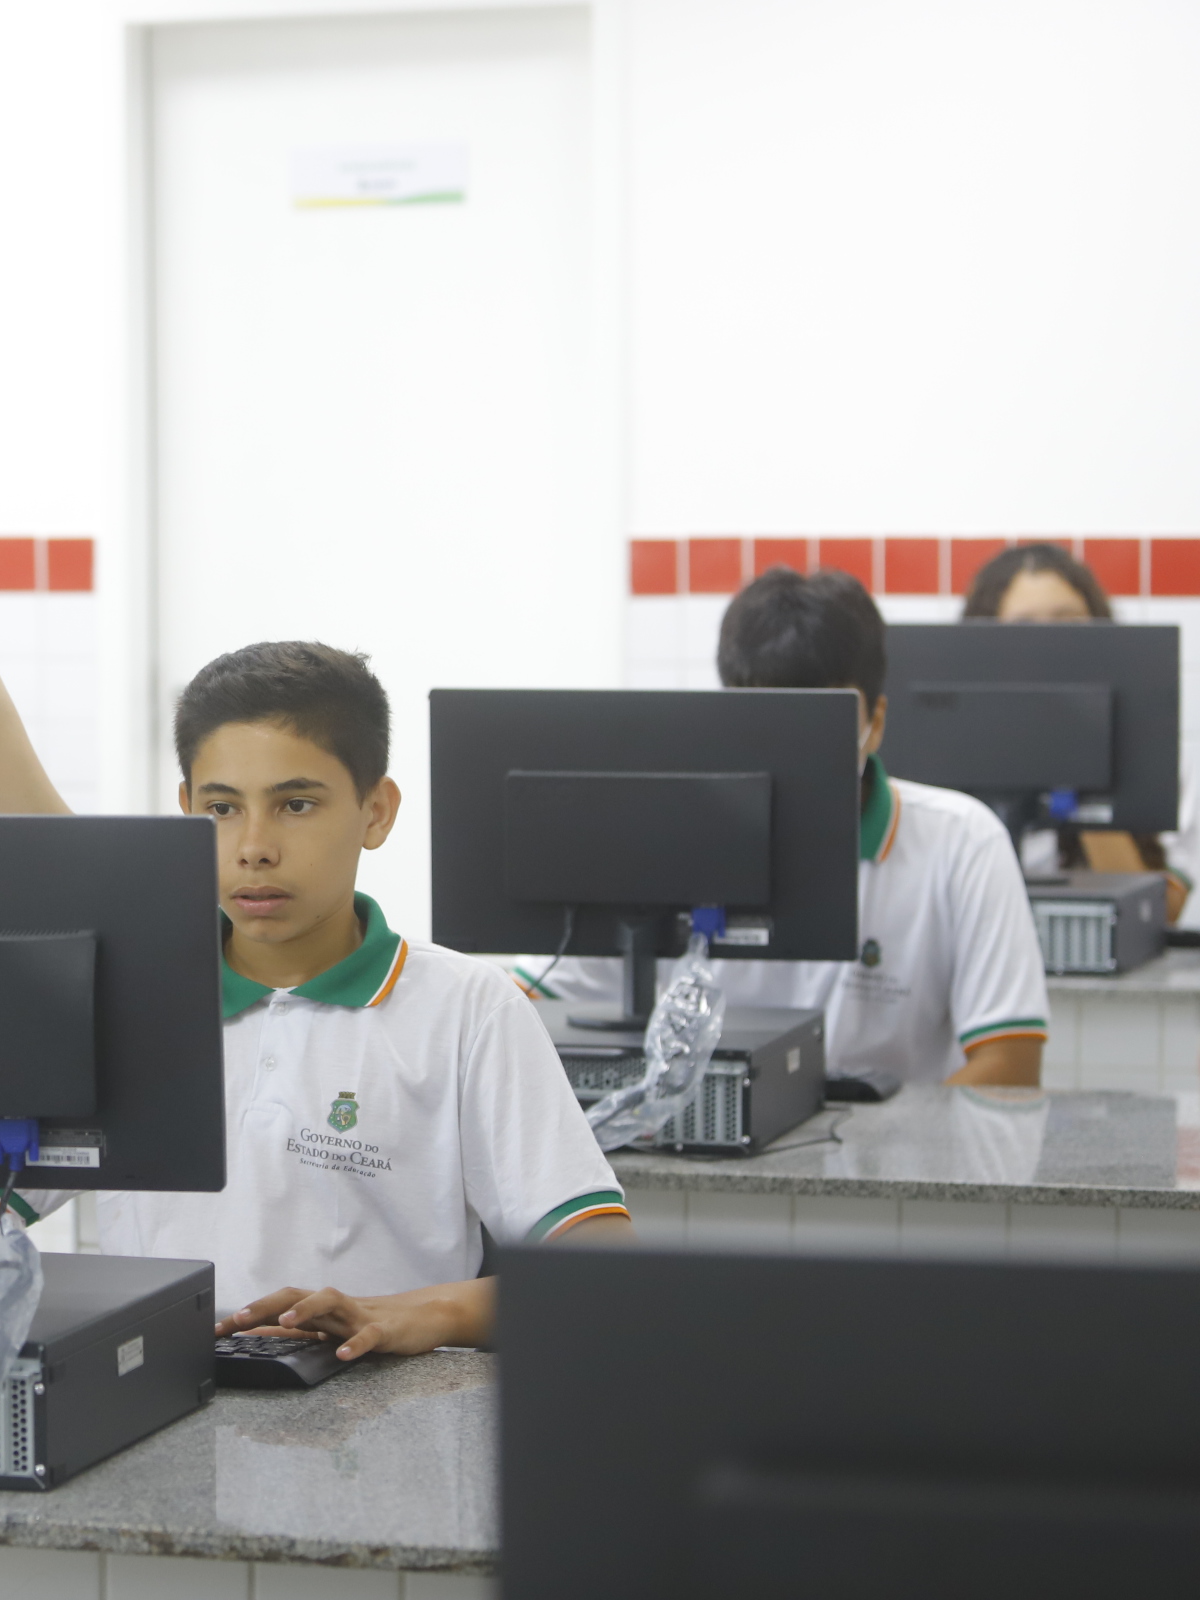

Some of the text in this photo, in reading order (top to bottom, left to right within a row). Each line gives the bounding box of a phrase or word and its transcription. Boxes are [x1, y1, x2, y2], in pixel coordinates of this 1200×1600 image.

[300, 1128, 362, 1150] GOVERNO
[286, 1138, 329, 1160] ESTADO
[349, 1151, 393, 1171] CEARÁ
